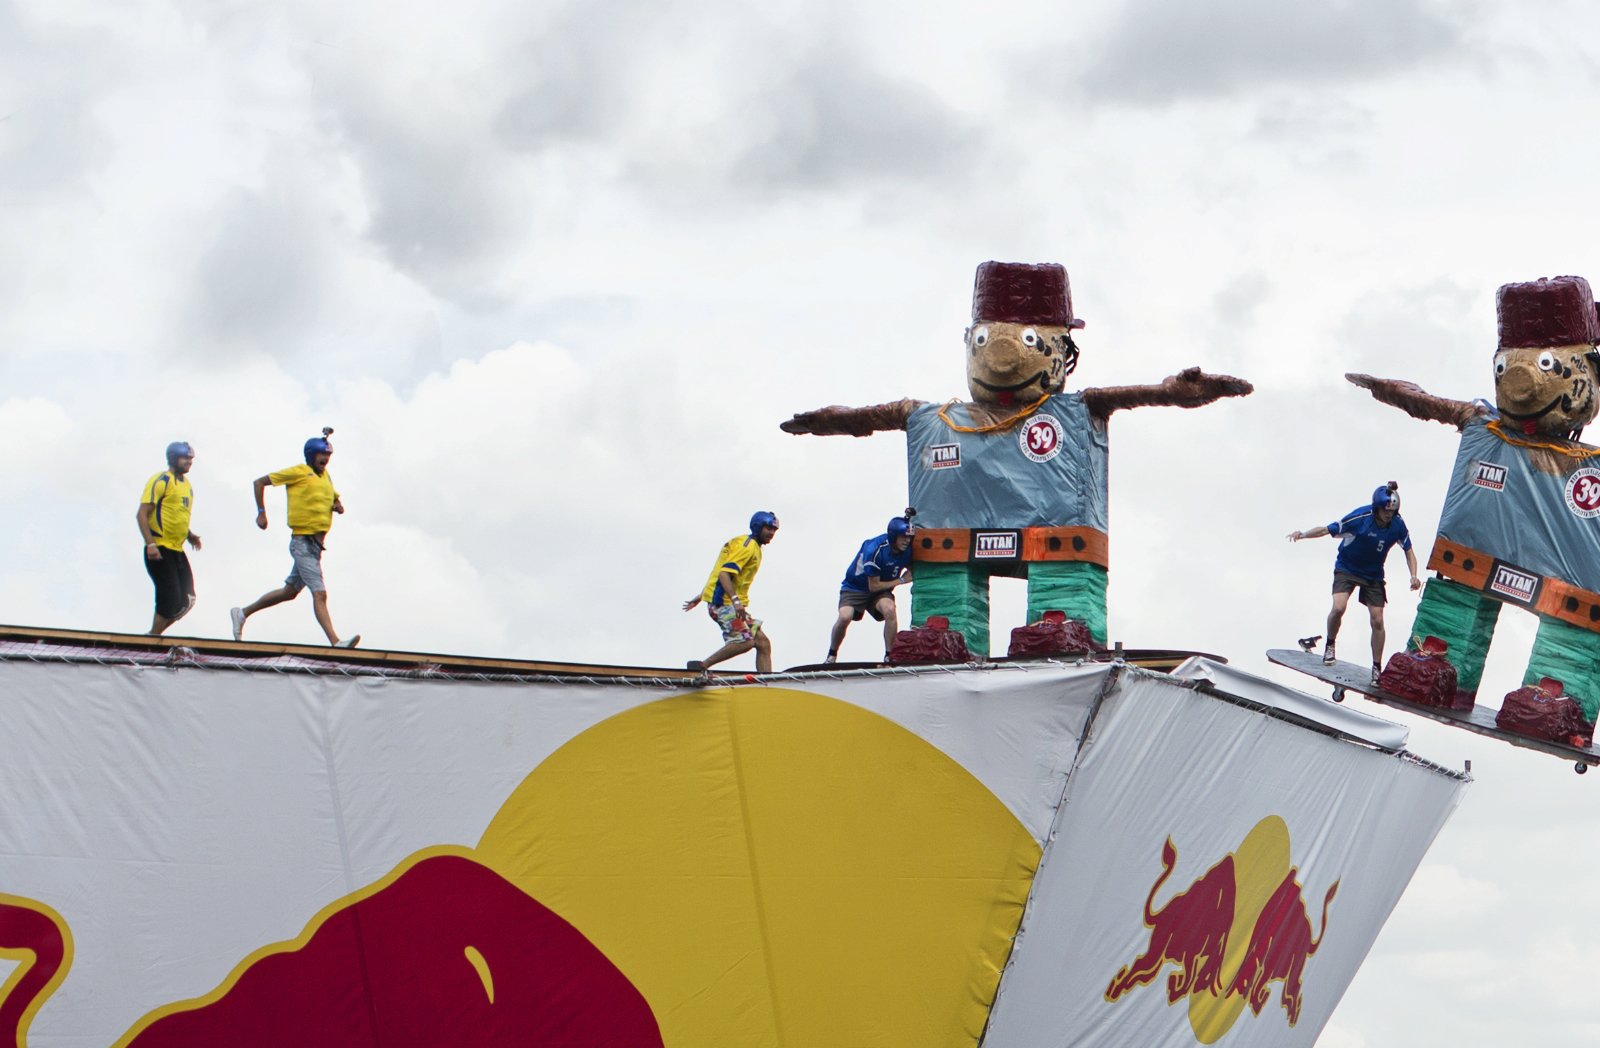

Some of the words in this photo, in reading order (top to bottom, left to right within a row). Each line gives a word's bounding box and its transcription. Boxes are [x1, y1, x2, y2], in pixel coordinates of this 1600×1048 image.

[1572, 378, 1587, 398] 17
[1031, 426, 1053, 449] 39
[980, 536, 1013, 550] TYTAN
[1376, 540, 1385, 552] 5
[1499, 569, 1533, 594] TYTAN
